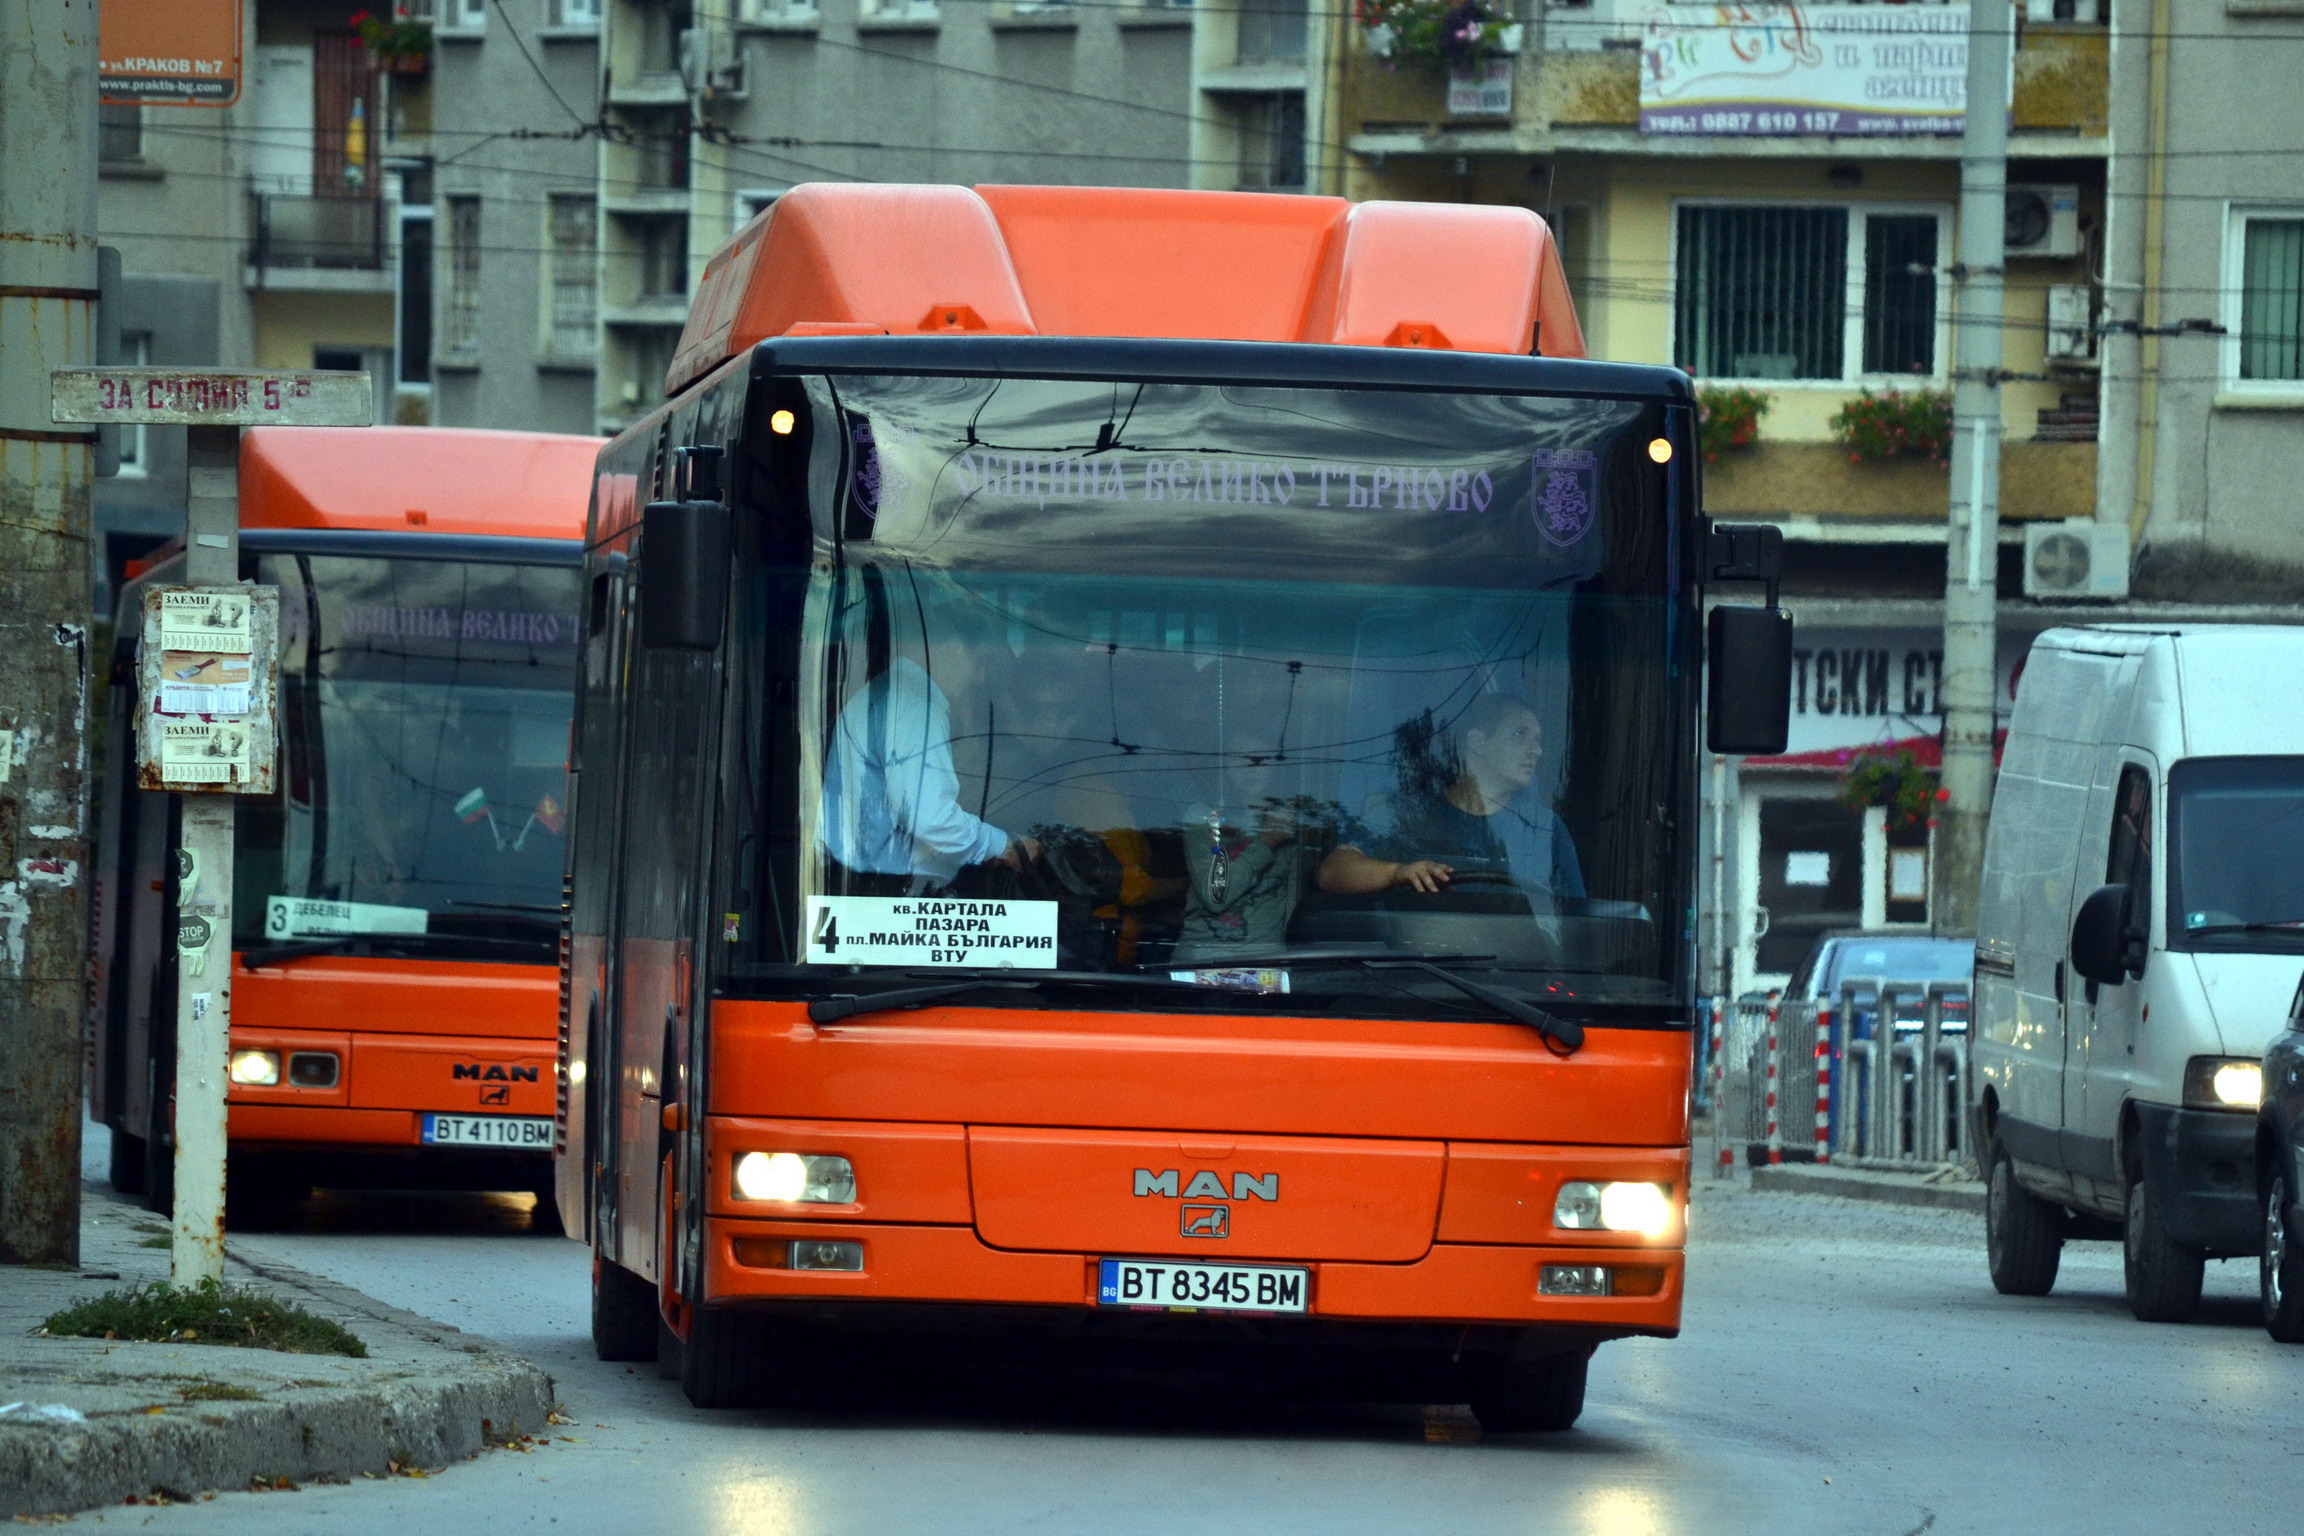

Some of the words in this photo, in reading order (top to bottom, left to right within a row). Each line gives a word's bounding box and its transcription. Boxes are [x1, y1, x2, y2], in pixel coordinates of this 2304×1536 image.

[100, 79, 223, 93] www.praktis-bg.com
[1701, 112, 1752, 132] 0887
[1757, 112, 1797, 132] 610
[1802, 112, 1839, 132] 157
[99, 379, 133, 410] ЗА
[957, 452, 1129, 512] ОБЩИНА
[1144, 458, 1296, 506] ВЕЛИКО
[1311, 464, 1494, 513] ТЪРНОВО
[165, 595, 210, 605] ЗАЕМИ
[1793, 649, 1889, 716] ТСКИ
[165, 725, 210, 735] ЗАЕМИ
[271, 904, 287, 931] 3
[915, 918, 991, 932] ПАЗАРА
[179, 925, 204, 938] STOP
[811, 906, 840, 954] 4
[947, 934, 1053, 949] БЪЛГАРИЯ
[931, 950, 968, 963] ВТУ
[453, 1063, 539, 1083] MAN
[437, 1118, 465, 1139] BT
[469, 1120, 518, 1141] 4110
[523, 1122, 551, 1144] BM
[1133, 1168, 1280, 1202] MAN
[1102, 1286, 1117, 1298] BG
[1122, 1267, 1166, 1300] BT
[1172, 1269, 1251, 1304] 8345
[1256, 1272, 1300, 1307] BM
